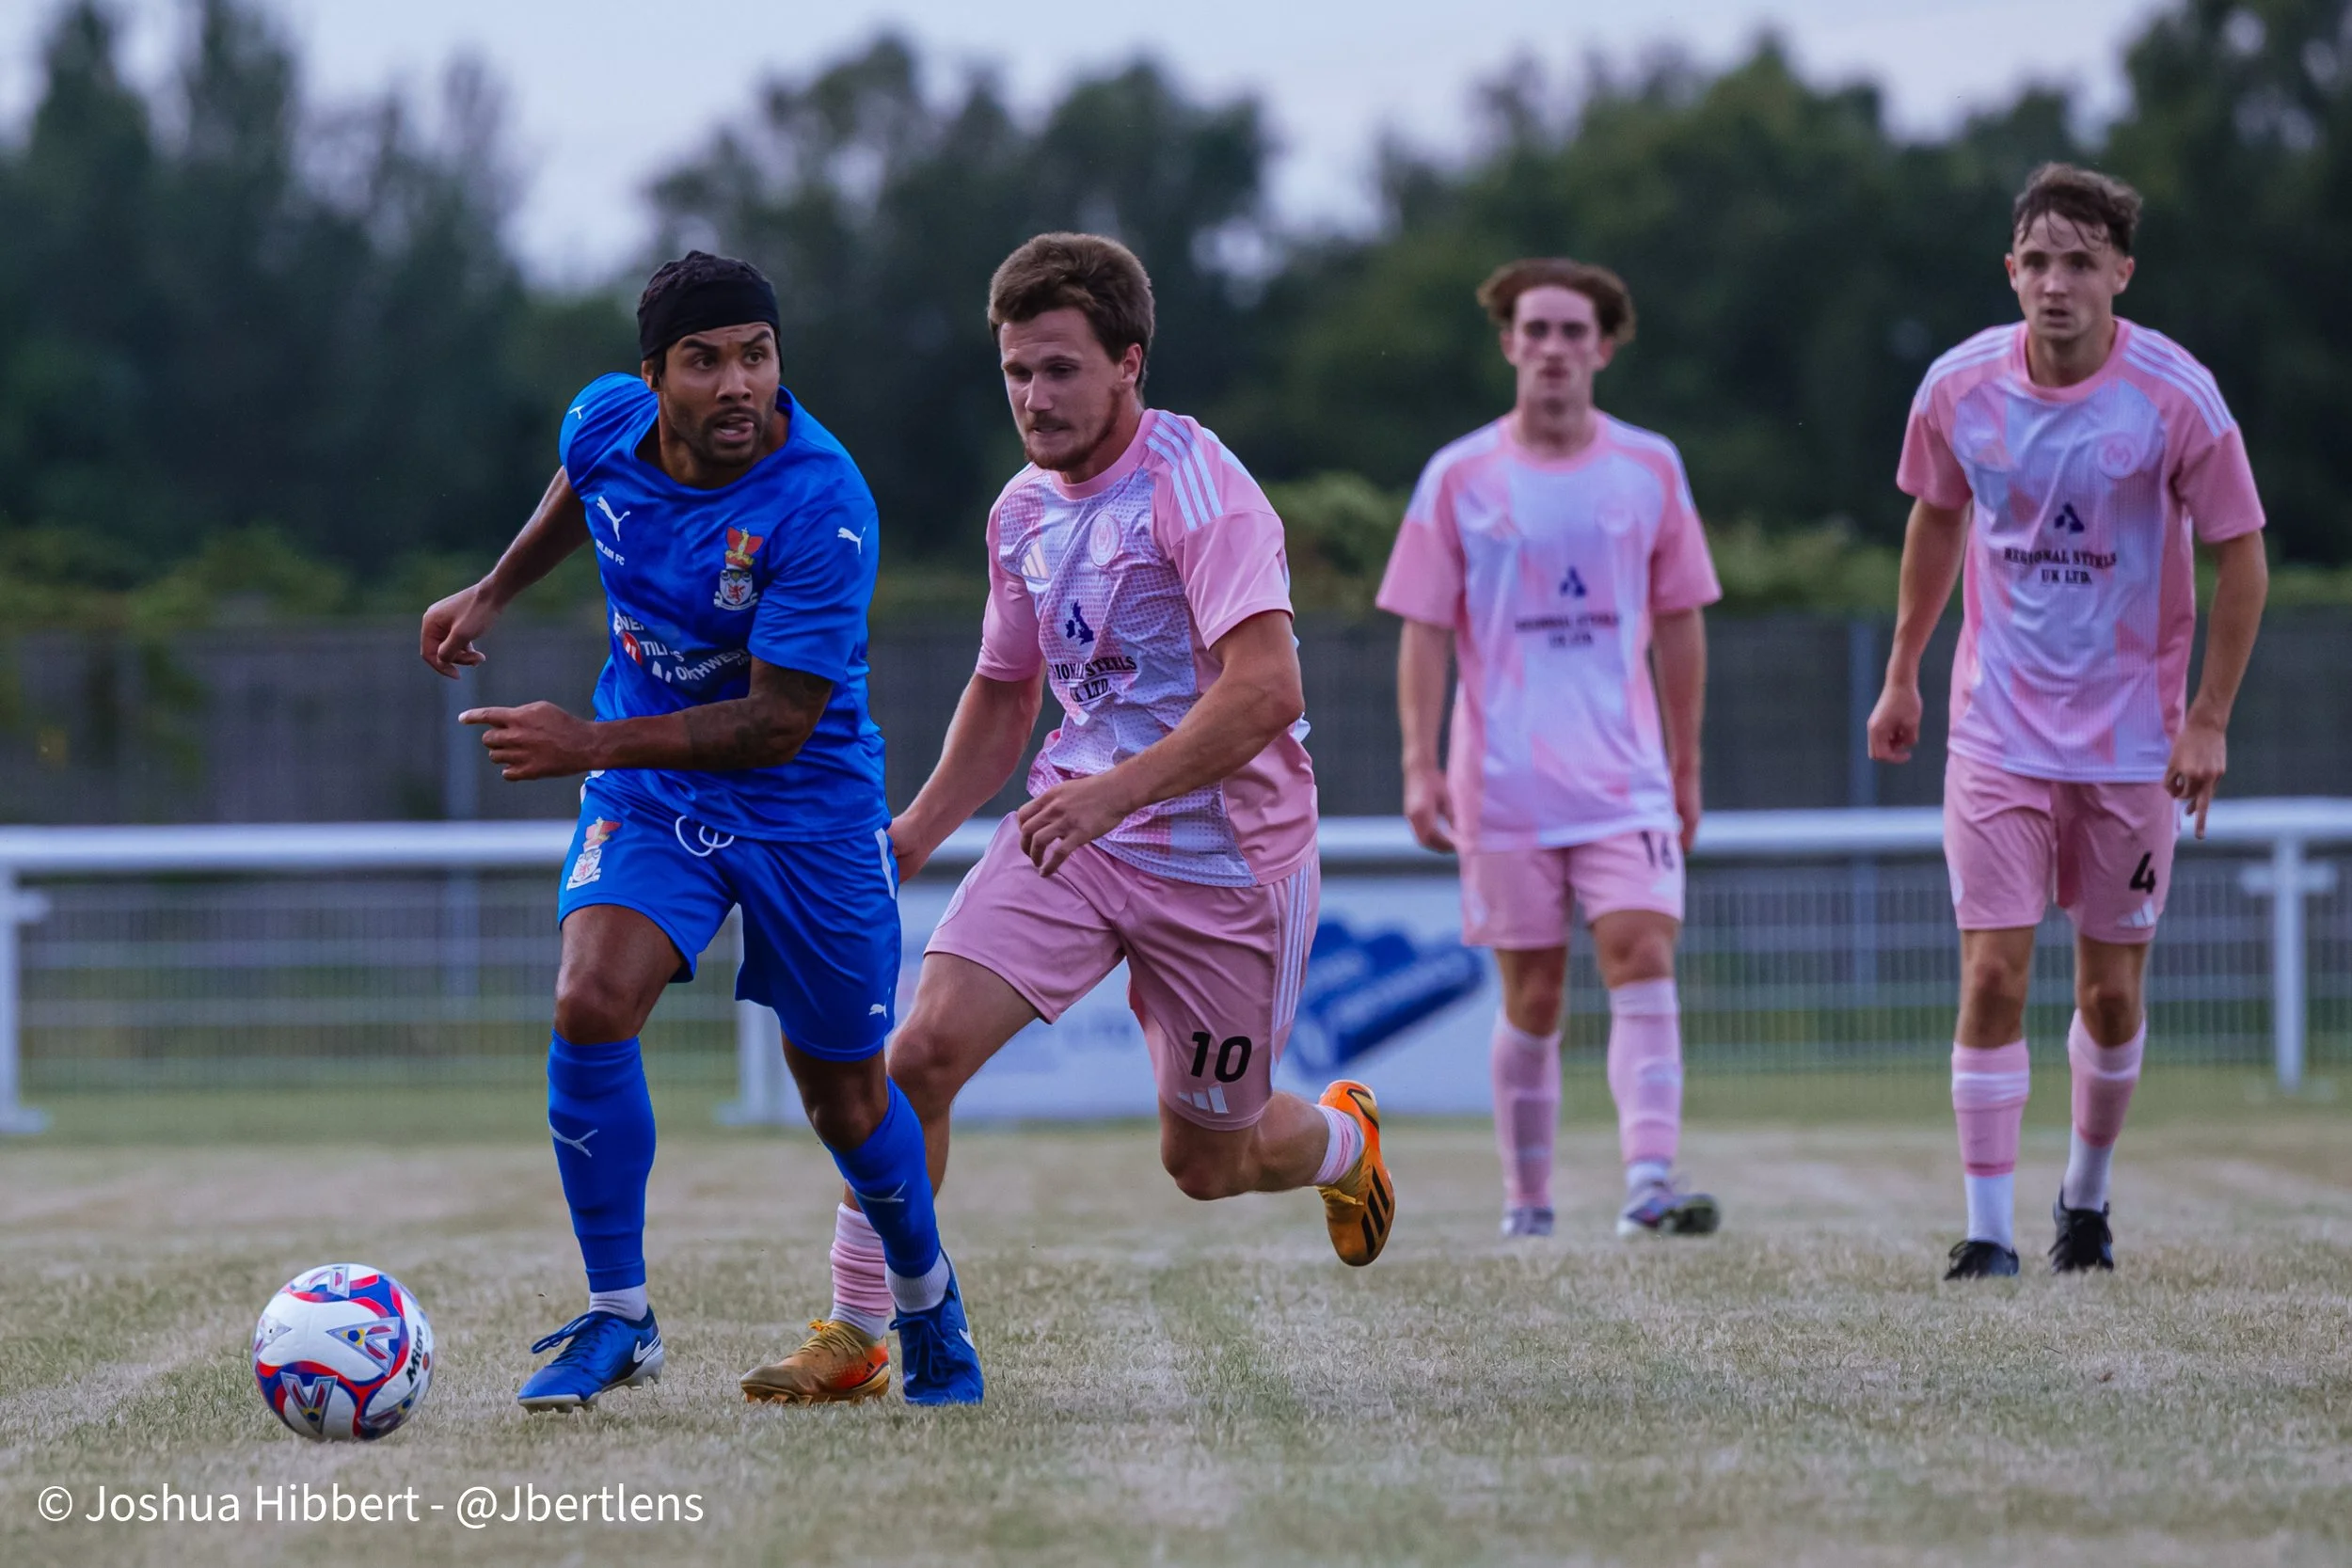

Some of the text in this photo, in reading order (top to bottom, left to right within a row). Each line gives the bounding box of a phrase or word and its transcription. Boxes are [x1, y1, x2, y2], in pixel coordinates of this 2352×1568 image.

[2042, 568, 2060, 583] UK
[1085, 656, 1137, 676] STEELS
[2129, 850, 2156, 895] 4
[1191, 1031, 1252, 1084] 10
